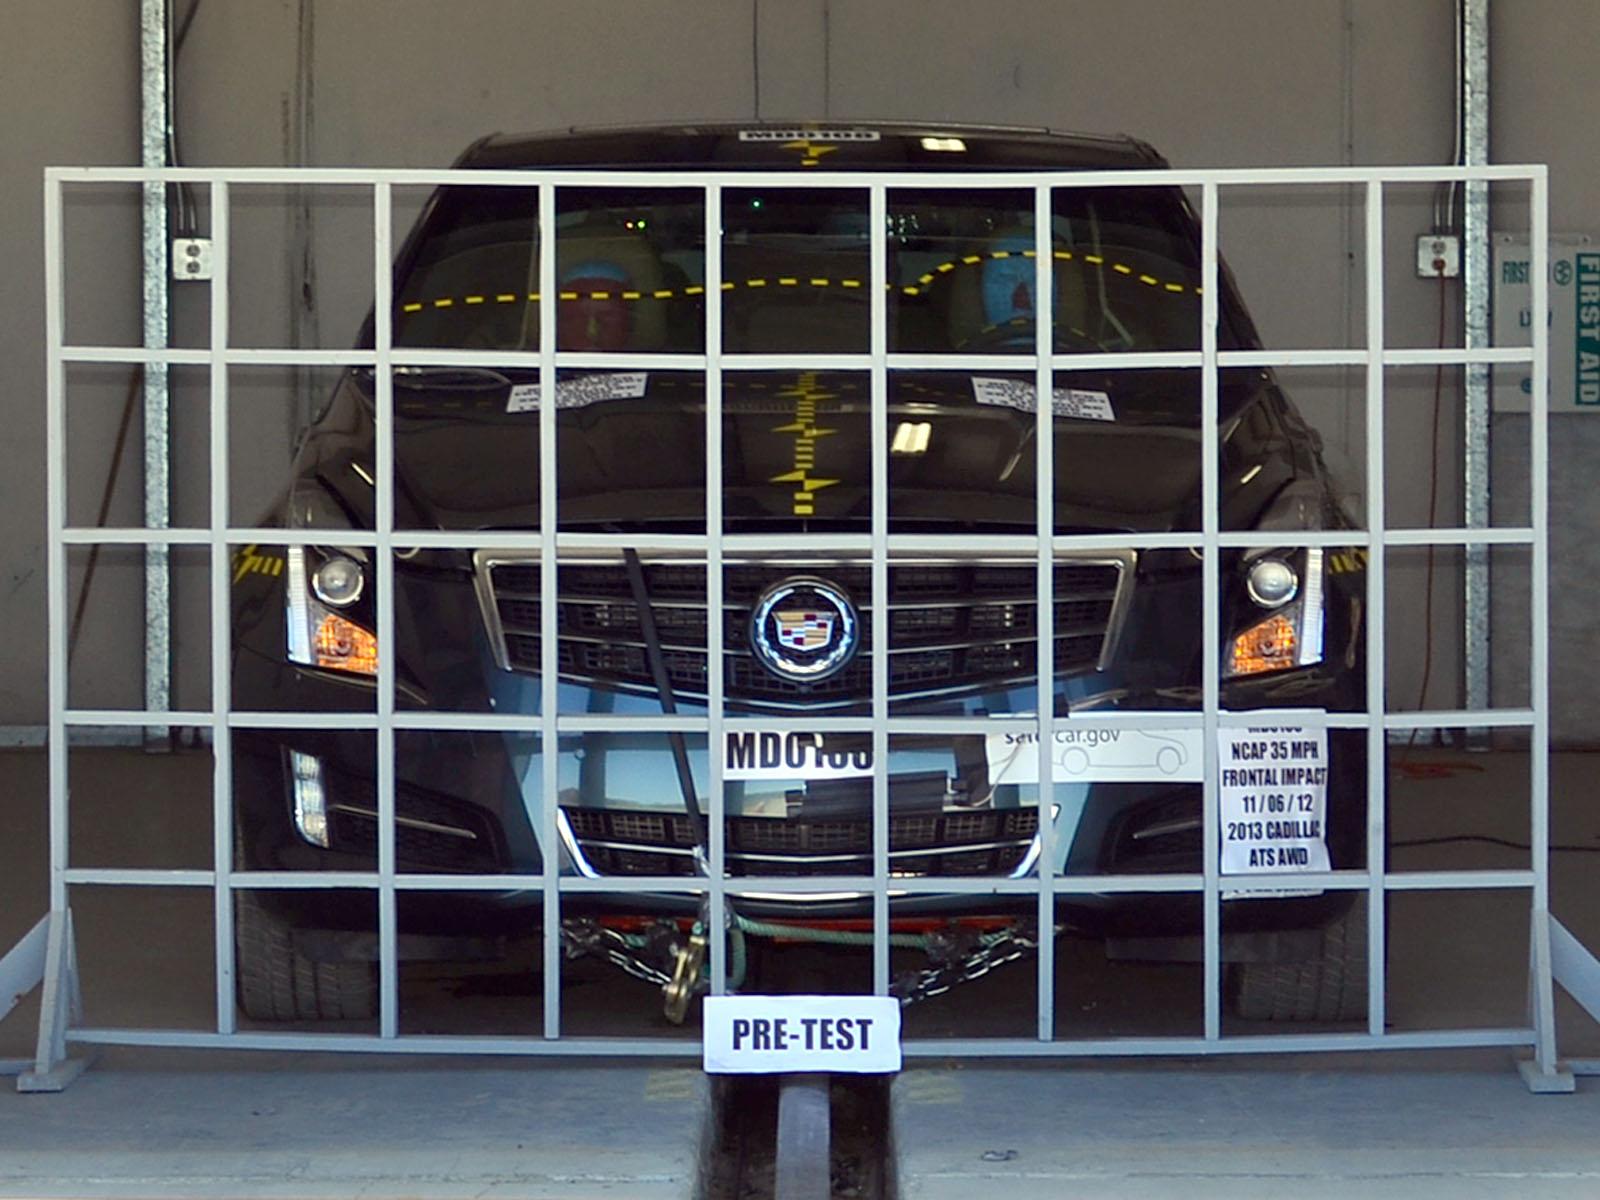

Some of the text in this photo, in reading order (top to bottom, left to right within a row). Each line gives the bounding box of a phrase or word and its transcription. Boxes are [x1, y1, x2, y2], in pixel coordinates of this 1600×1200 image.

[1580, 255, 1600, 402] FIRST AID
[1231, 741, 1268, 760] NCAP
[1270, 741, 1288, 760] 35
[1222, 767, 1327, 787] FRONTAL IMPACT
[1228, 820, 1320, 841] 2013 CADILLAC
[1249, 847, 1308, 867] ATS AWD
[732, 1018, 873, 1051] PRE-TEST
